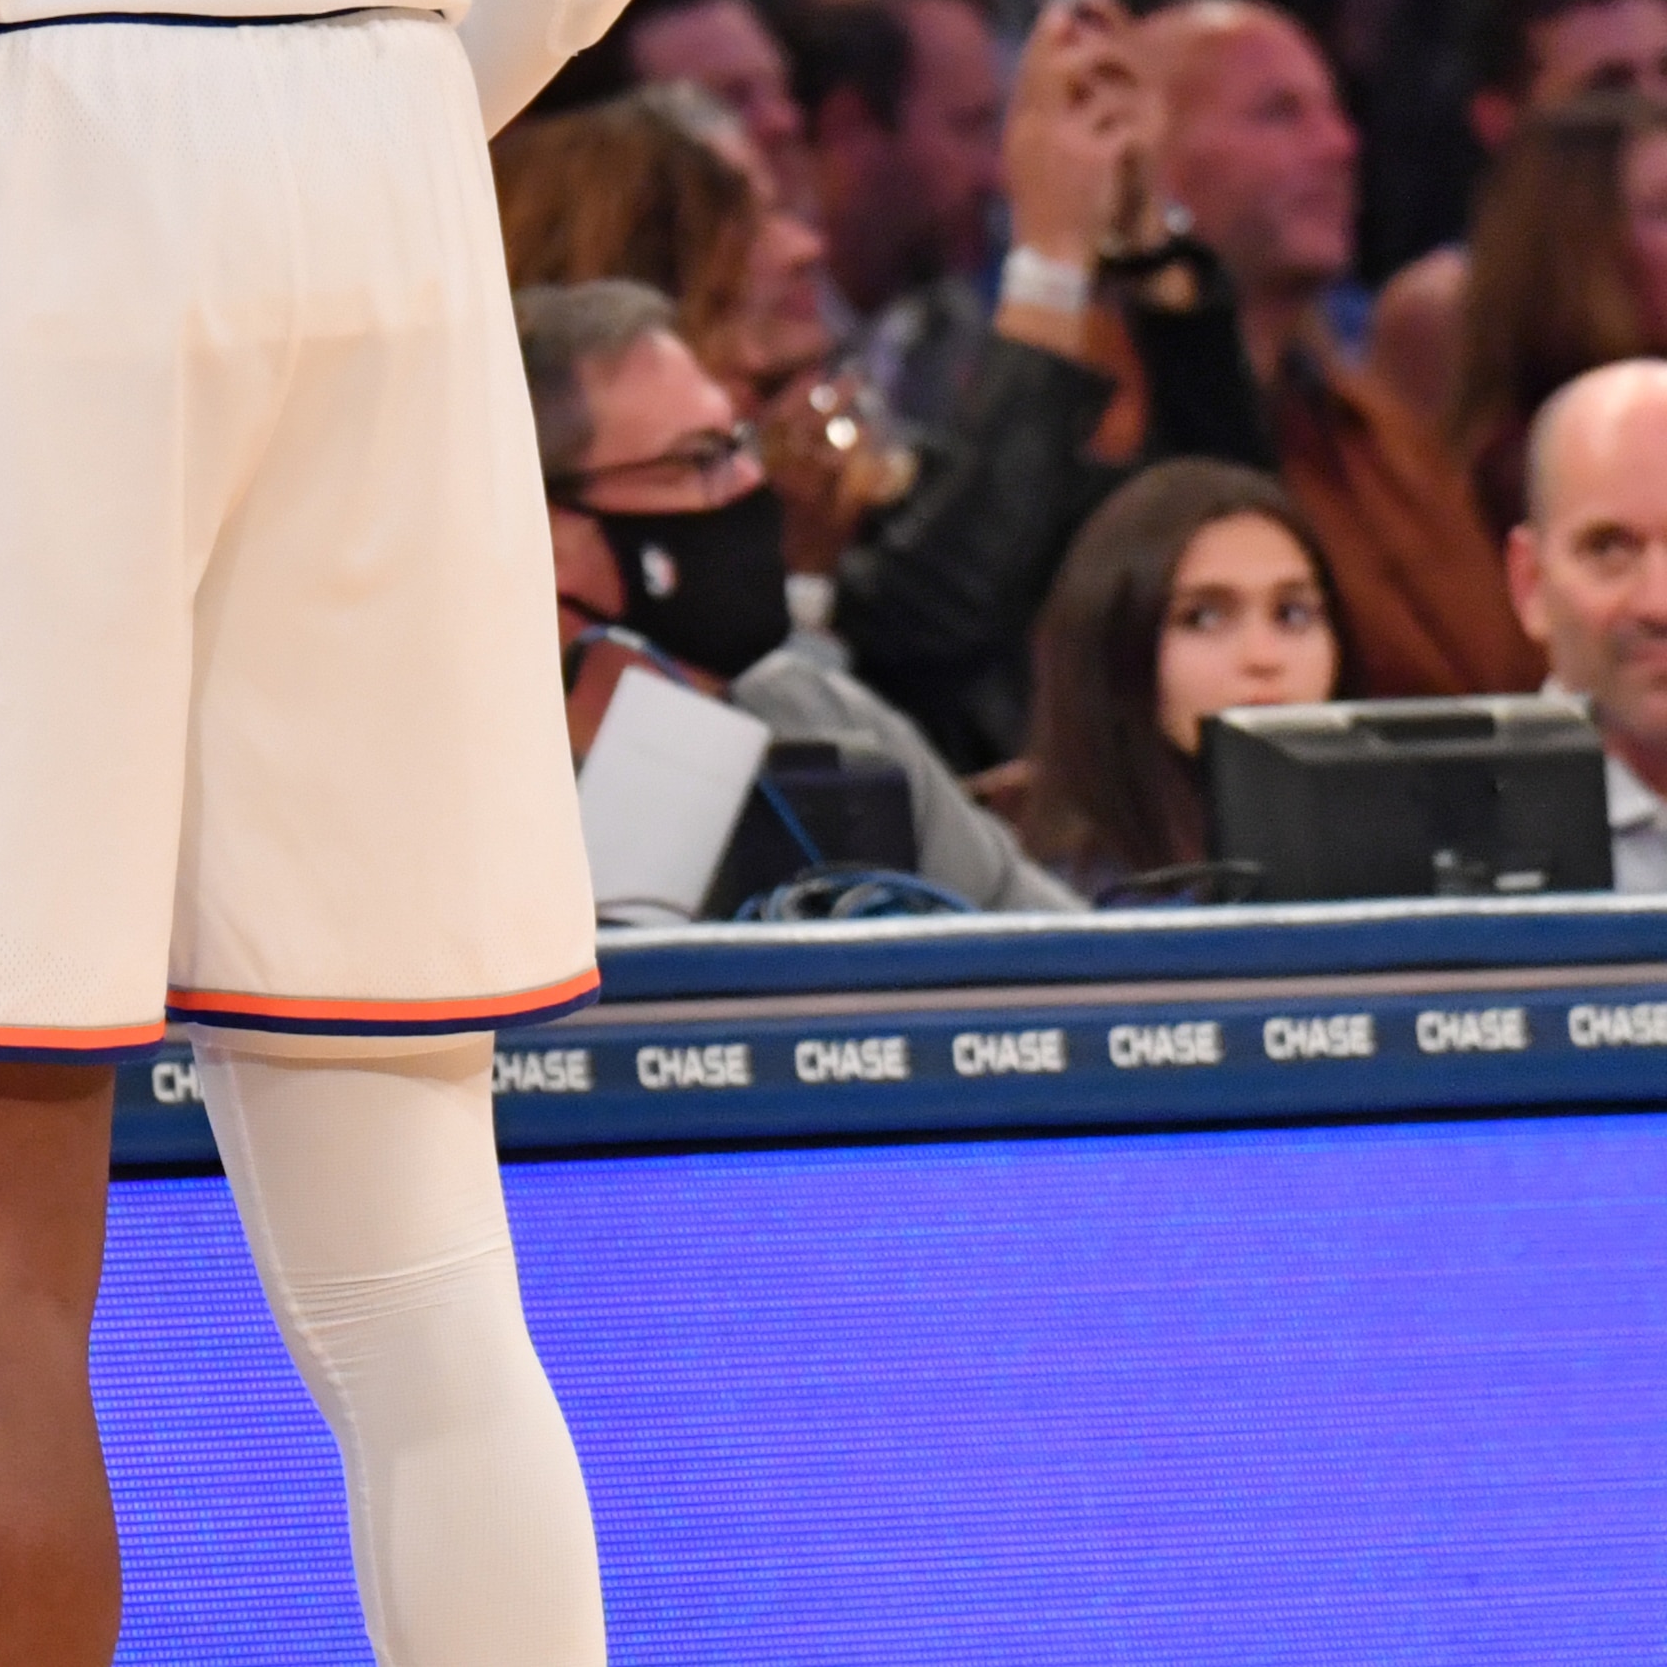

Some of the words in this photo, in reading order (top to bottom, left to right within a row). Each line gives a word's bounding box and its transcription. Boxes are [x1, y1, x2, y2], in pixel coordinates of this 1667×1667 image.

[636, 1044, 750, 1089] CHASE
[794, 1037, 909, 1082] CHASE
[951, 1029, 1065, 1074] CHASE
[1108, 1022, 1221, 1067] CHASE
[1262, 1014, 1374, 1060] CHASE
[1415, 1008, 1527, 1053] CHASE
